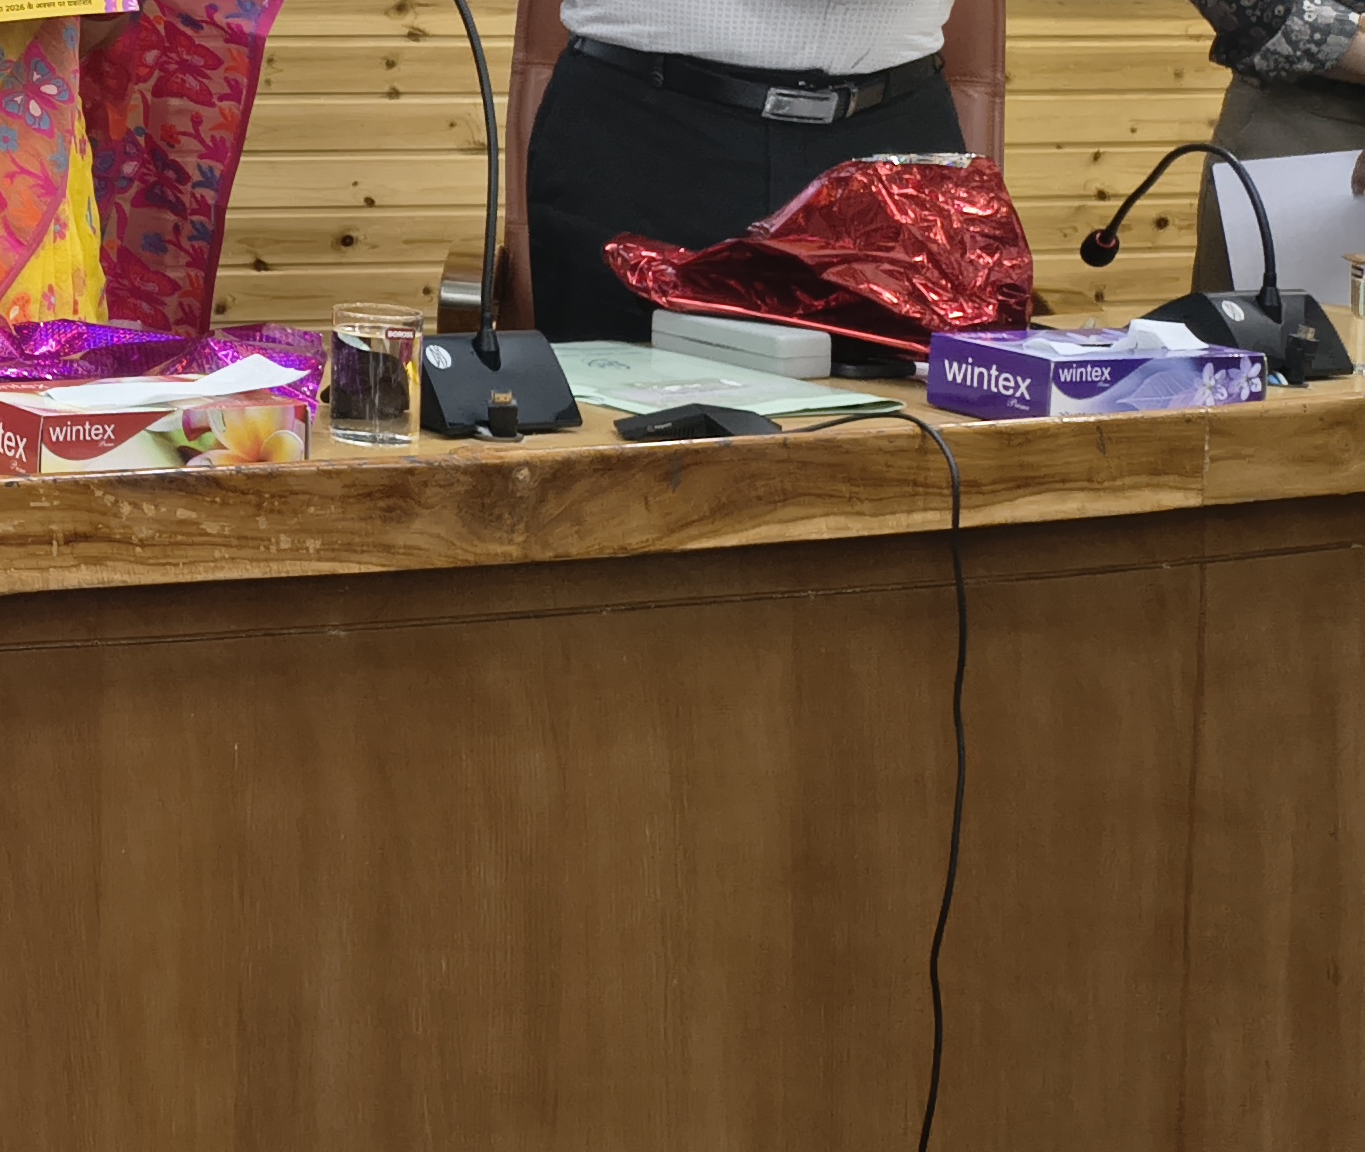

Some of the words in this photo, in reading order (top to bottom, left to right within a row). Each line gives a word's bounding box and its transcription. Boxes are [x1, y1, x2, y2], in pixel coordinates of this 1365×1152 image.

[944, 357, 1032, 400] wintex
[1059, 364, 1111, 382] wintex
[49, 421, 116, 442] wintex
